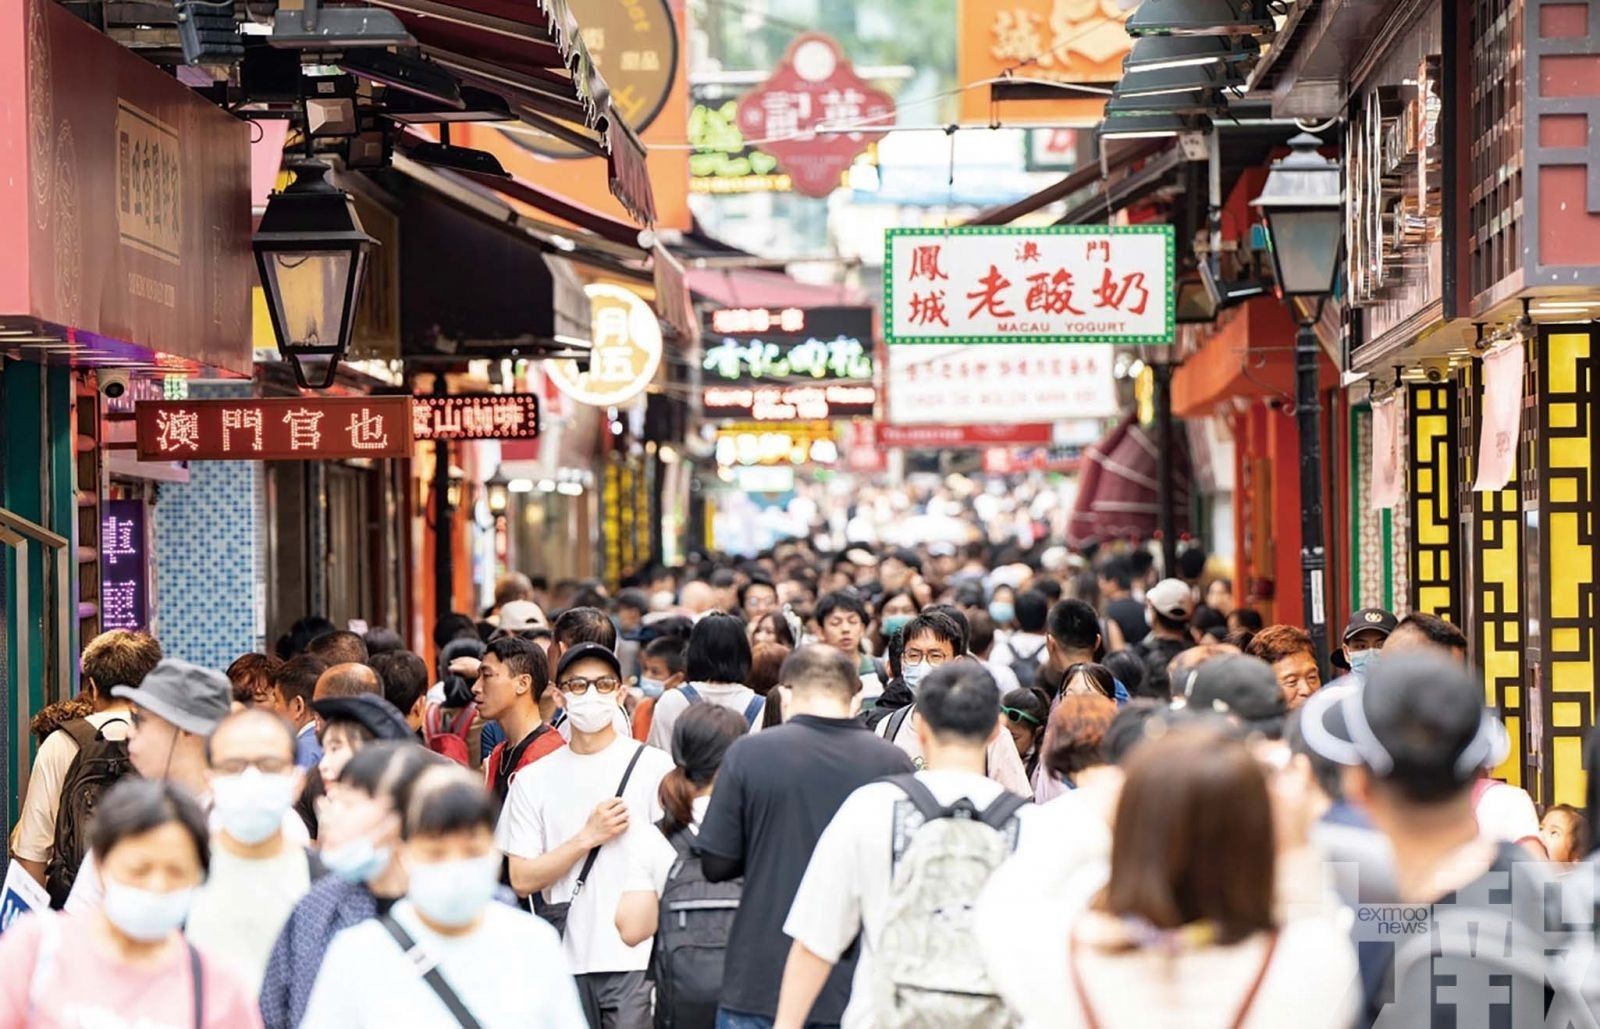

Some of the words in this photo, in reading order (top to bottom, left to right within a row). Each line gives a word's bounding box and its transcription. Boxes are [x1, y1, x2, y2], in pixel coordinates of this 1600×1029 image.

[1015, 240, 1110, 263] 澳門
[908, 244, 949, 328] 鳳城
[966, 264, 1150, 320] 老酸奶
[997, 321, 1050, 333] MACAU
[1065, 320, 1127, 333] YOGURT
[156, 408, 388, 452] 澳門官也
